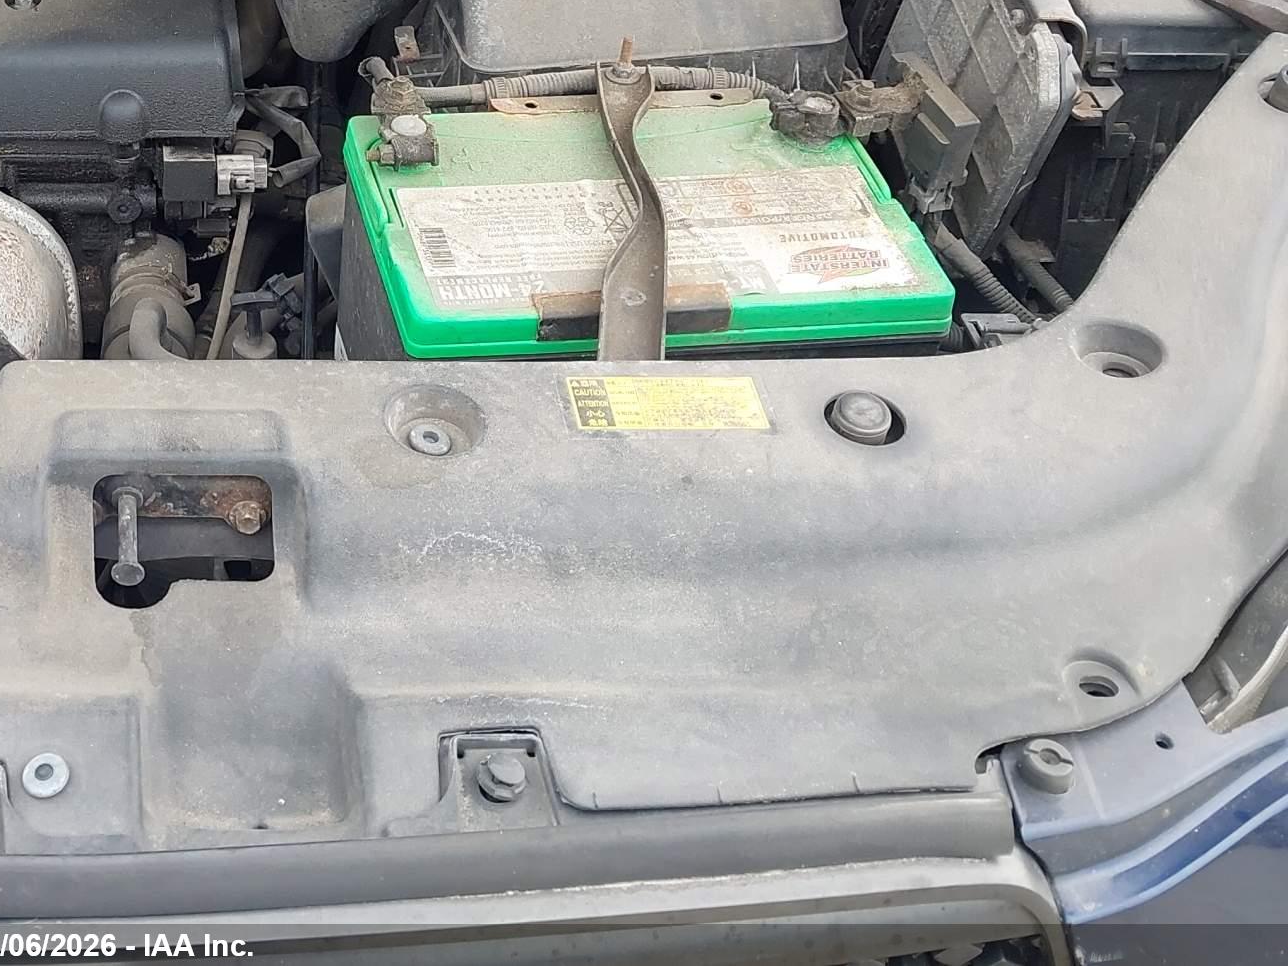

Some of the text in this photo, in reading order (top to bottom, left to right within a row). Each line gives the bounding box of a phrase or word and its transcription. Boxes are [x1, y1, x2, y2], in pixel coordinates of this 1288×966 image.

[792, 250, 880, 263] BATTERIES
[791, 259, 888, 273] INTERSTATE
[438, 278, 547, 300] 24-MONTH
[574, 388, 607, 397] CAUTION
